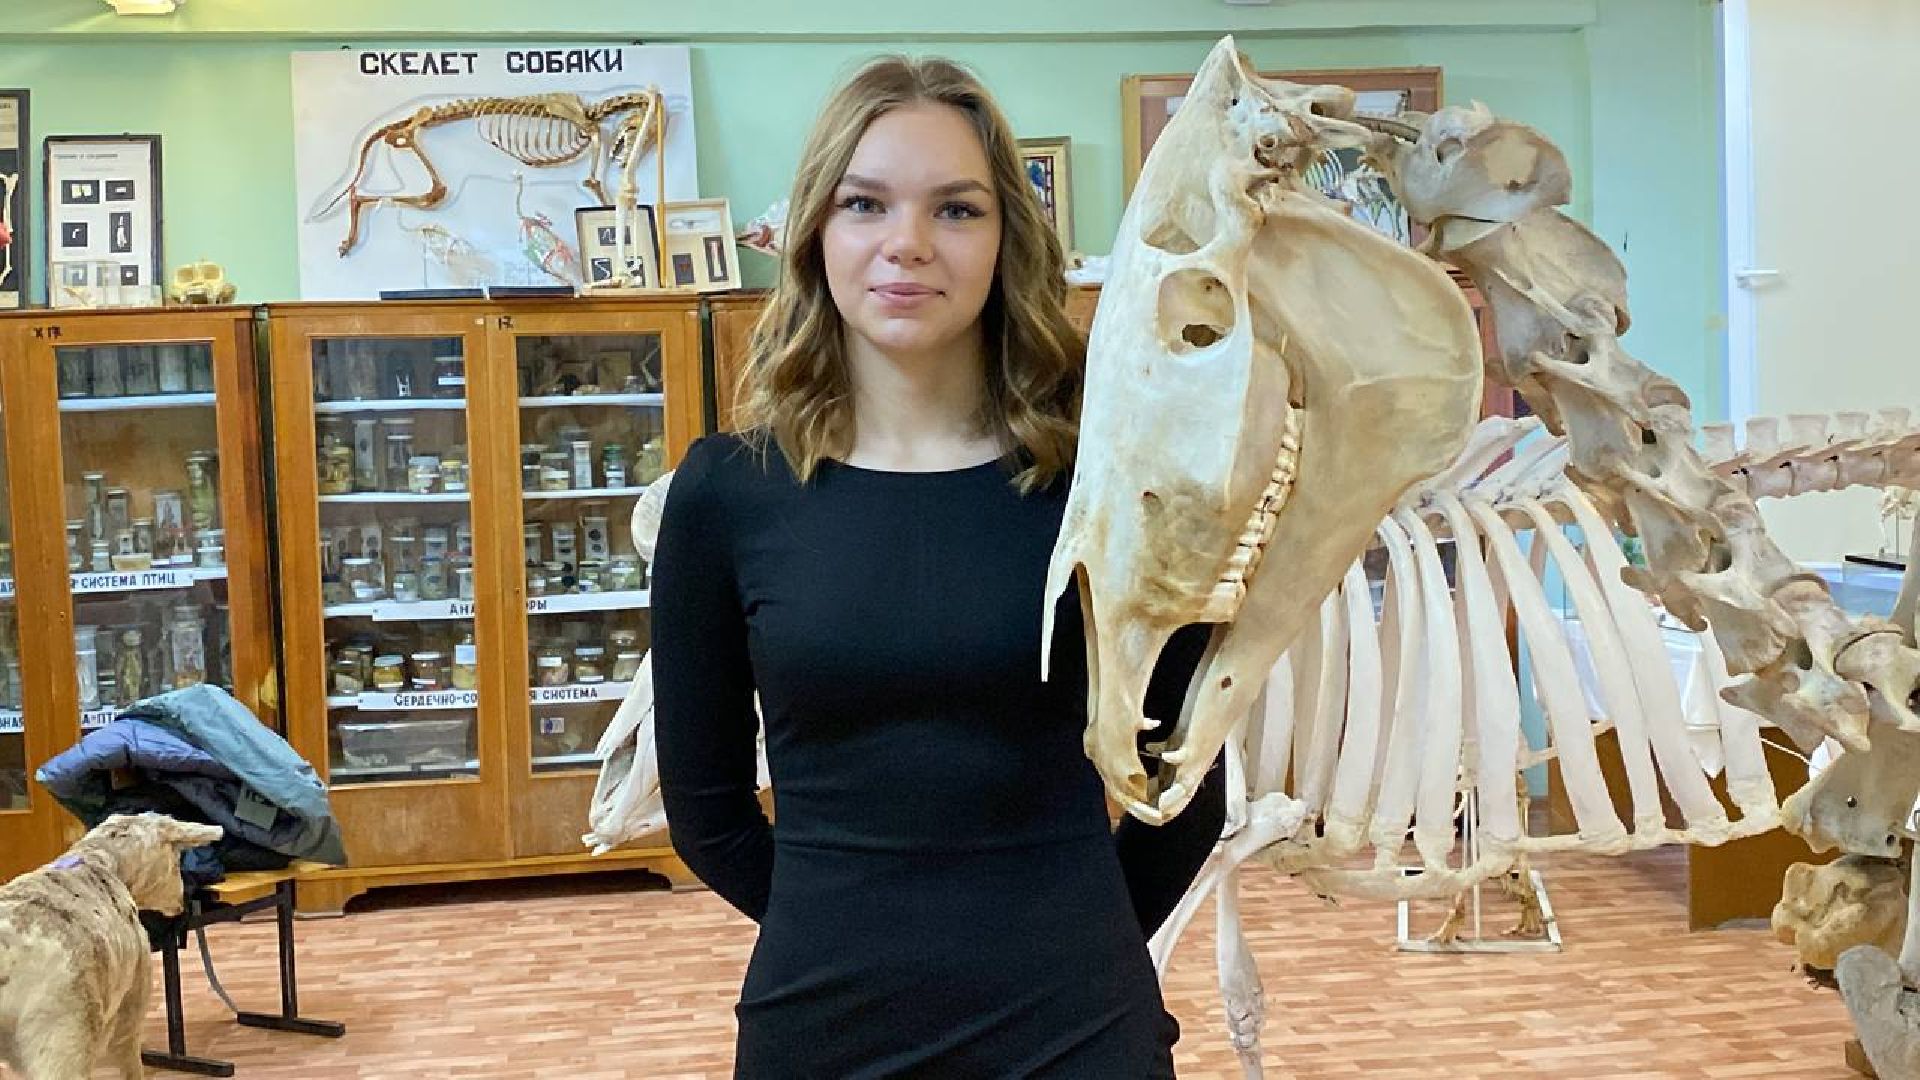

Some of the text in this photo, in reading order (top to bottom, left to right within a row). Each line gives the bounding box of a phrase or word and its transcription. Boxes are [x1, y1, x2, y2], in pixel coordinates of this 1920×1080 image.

[360, 49, 623, 75] СКЕЛЕТ СОБАКИ
[81, 575, 137, 589] СИСТЕМА
[143, 573, 176, 585] ПТИЦ
[543, 688, 598, 700] СИСТЕМА
